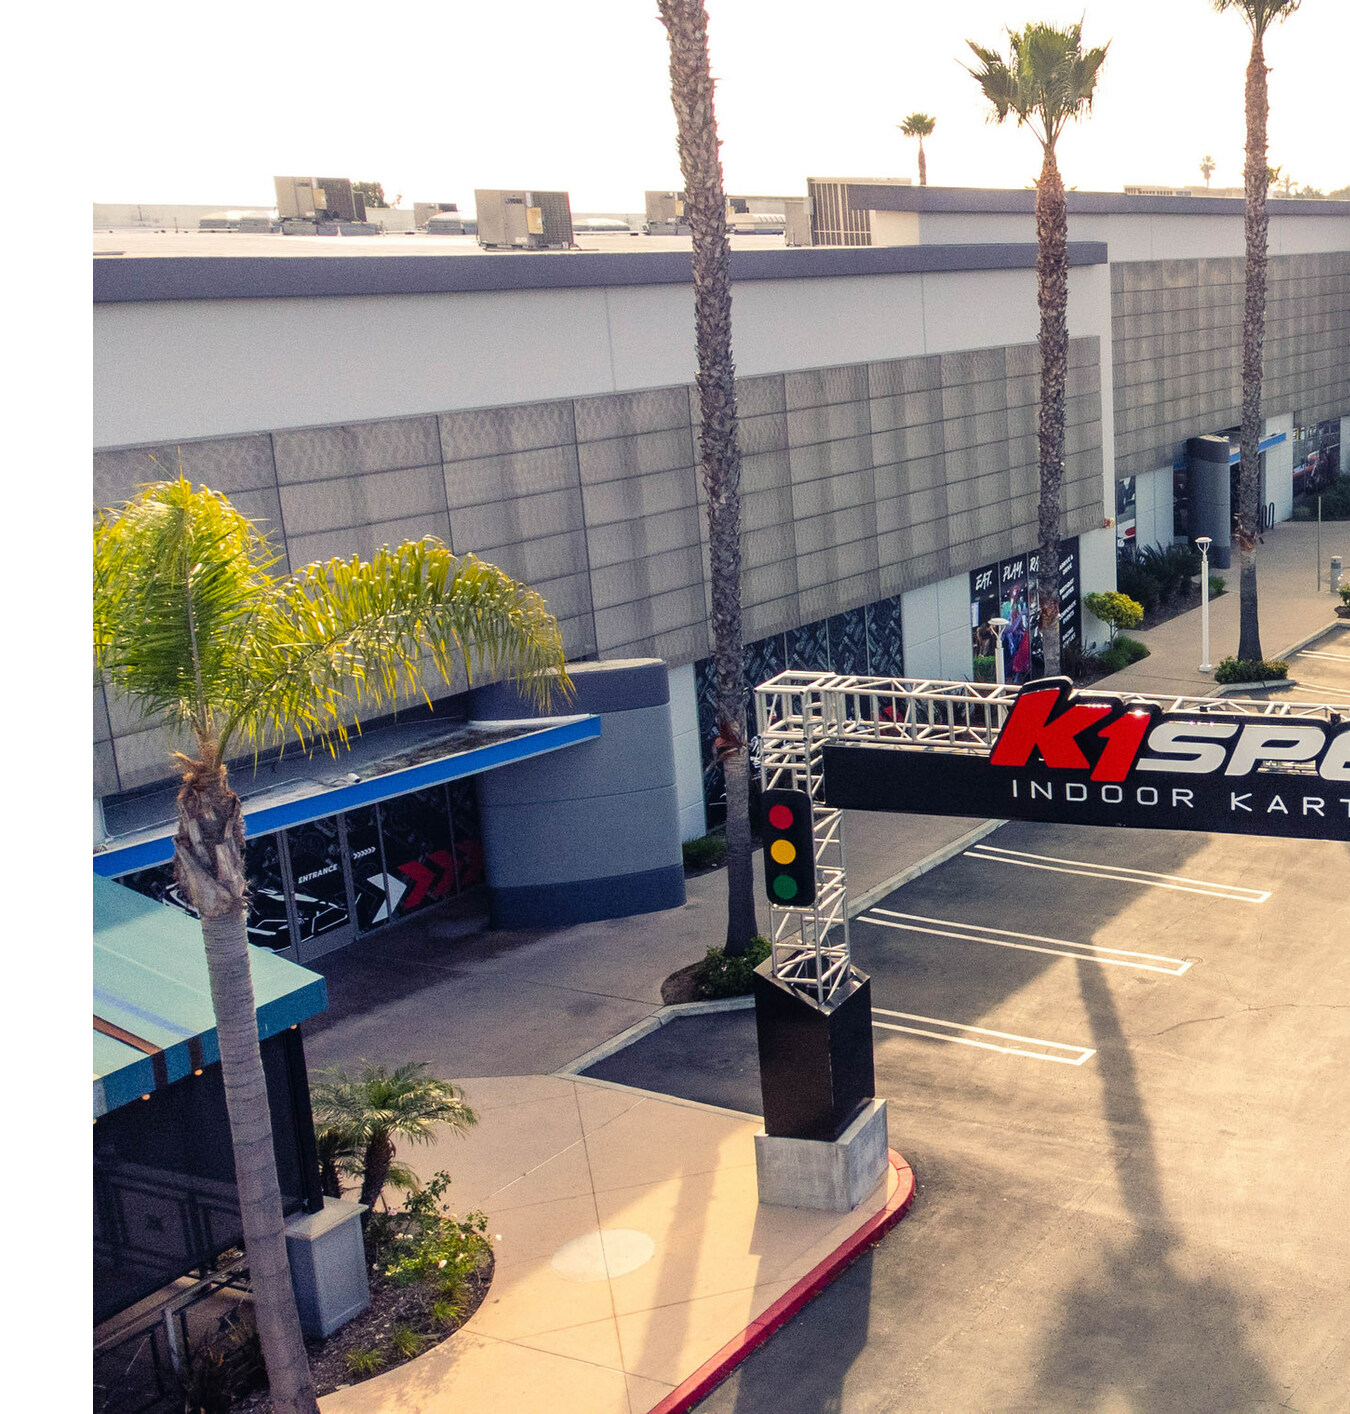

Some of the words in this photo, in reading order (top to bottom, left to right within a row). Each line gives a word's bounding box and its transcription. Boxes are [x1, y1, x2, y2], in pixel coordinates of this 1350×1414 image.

[1002, 561, 1024, 582] PLAY.
[1029, 555, 1039, 572] RA
[975, 570, 993, 591] EAT.
[990, 687, 1151, 782] K1
[1012, 779, 1194, 808] INDOOR
[298, 863, 338, 884] ENTRANCE
